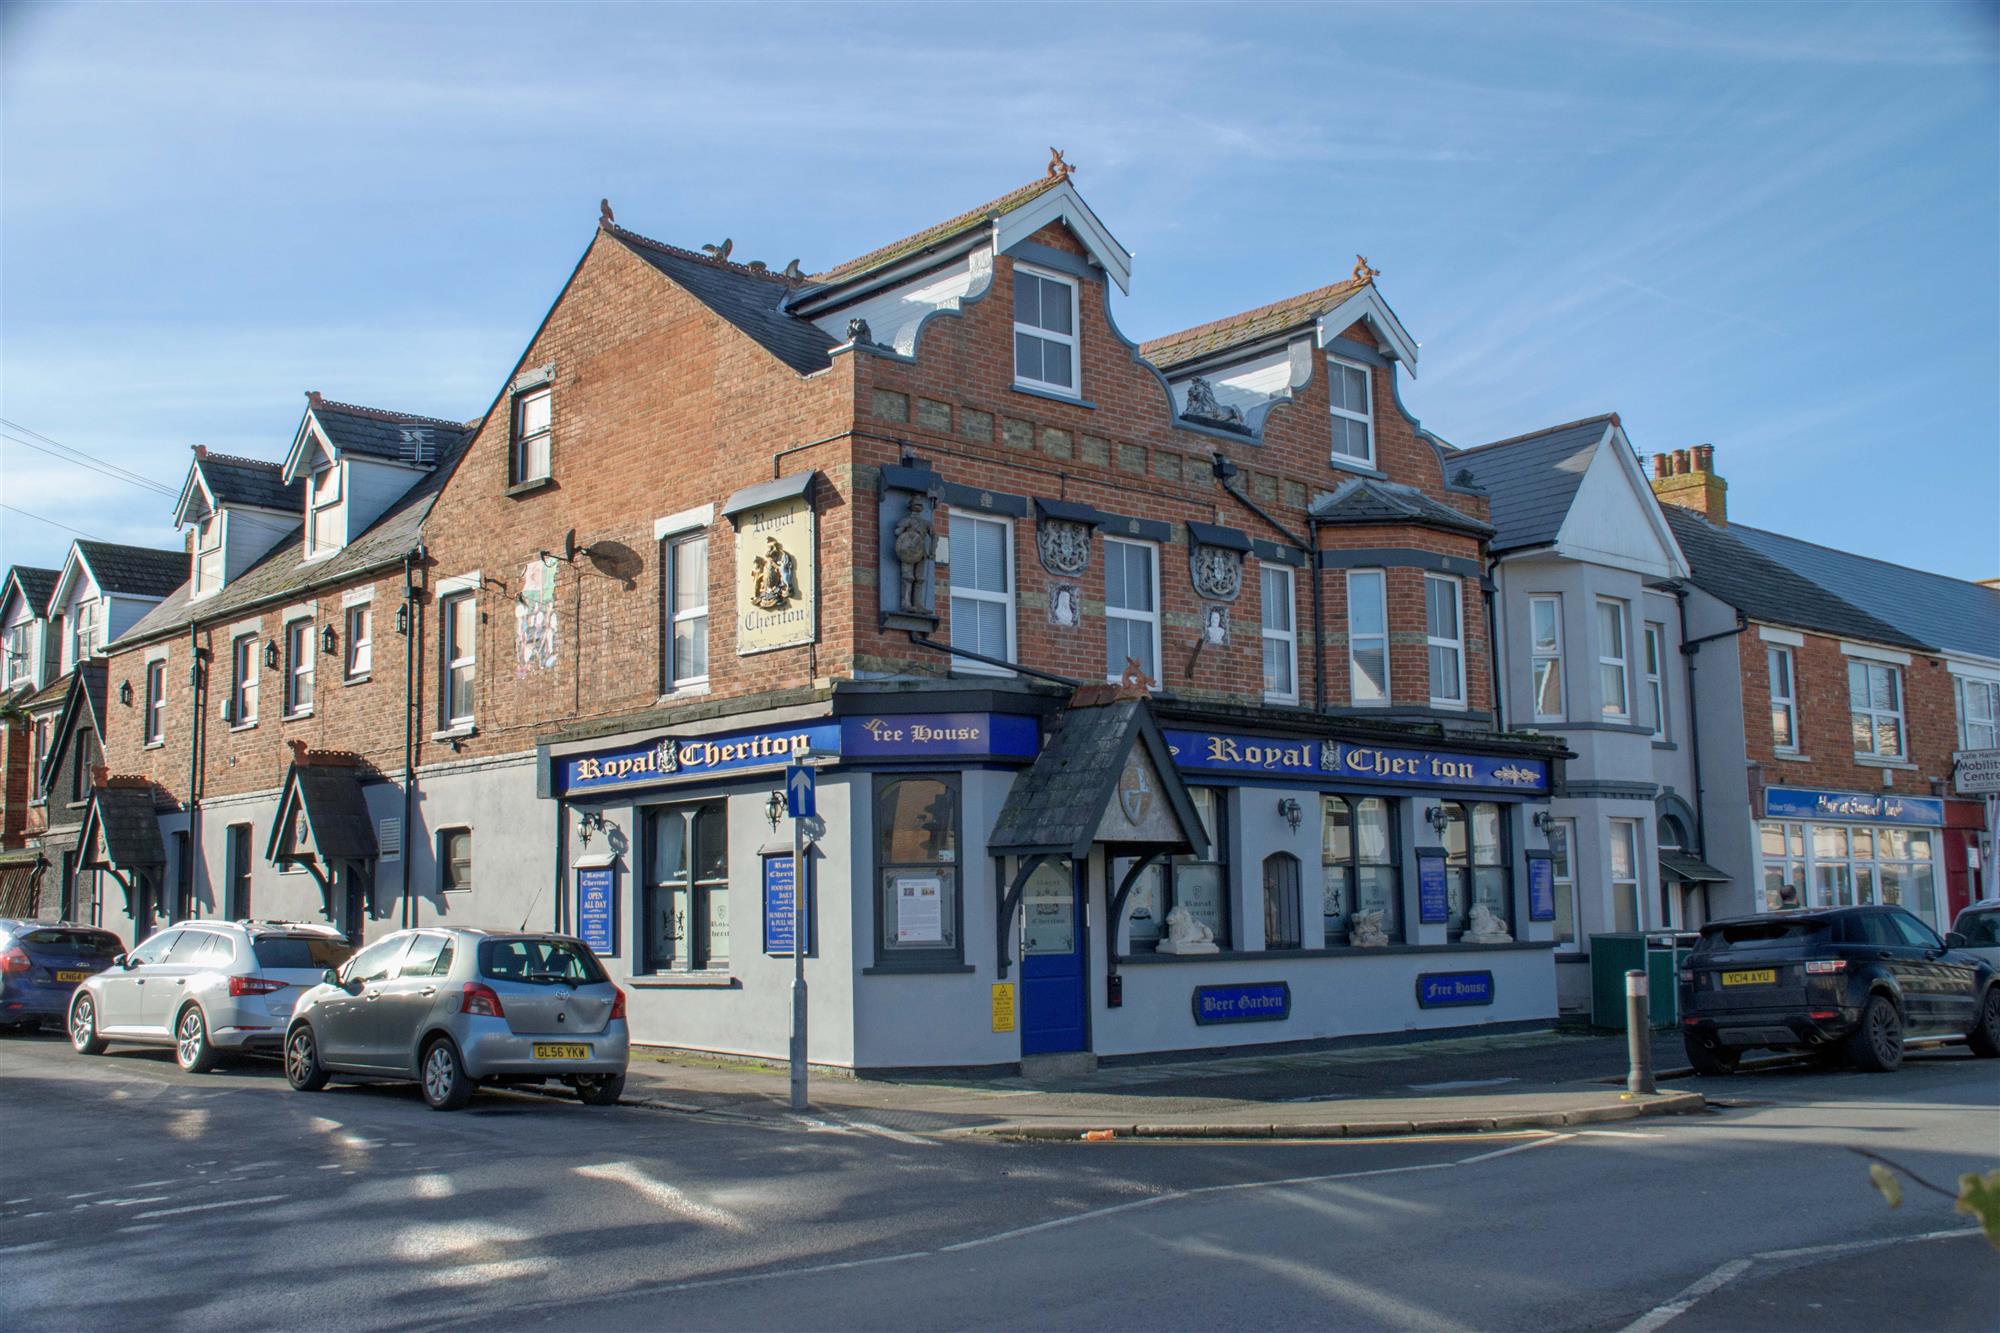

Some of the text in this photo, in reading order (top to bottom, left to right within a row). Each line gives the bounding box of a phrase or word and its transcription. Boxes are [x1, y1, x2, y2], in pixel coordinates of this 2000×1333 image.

[752, 506, 795, 536] Royal
[745, 608, 804, 633] Cheriton
[862, 719, 980, 743] Free House
[577, 734, 809, 780] Royal Cheriton
[1206, 736, 1474, 779] Royal Cherton
[584, 901, 607, 909] ALL DAY
[587, 892, 603, 900] OPEN
[1728, 972, 1748, 983] YC14
[1427, 981, 1486, 998] Free House
[1203, 994, 1283, 1012] Beer Garden
[537, 1046, 585, 1058] GL56 YKW
